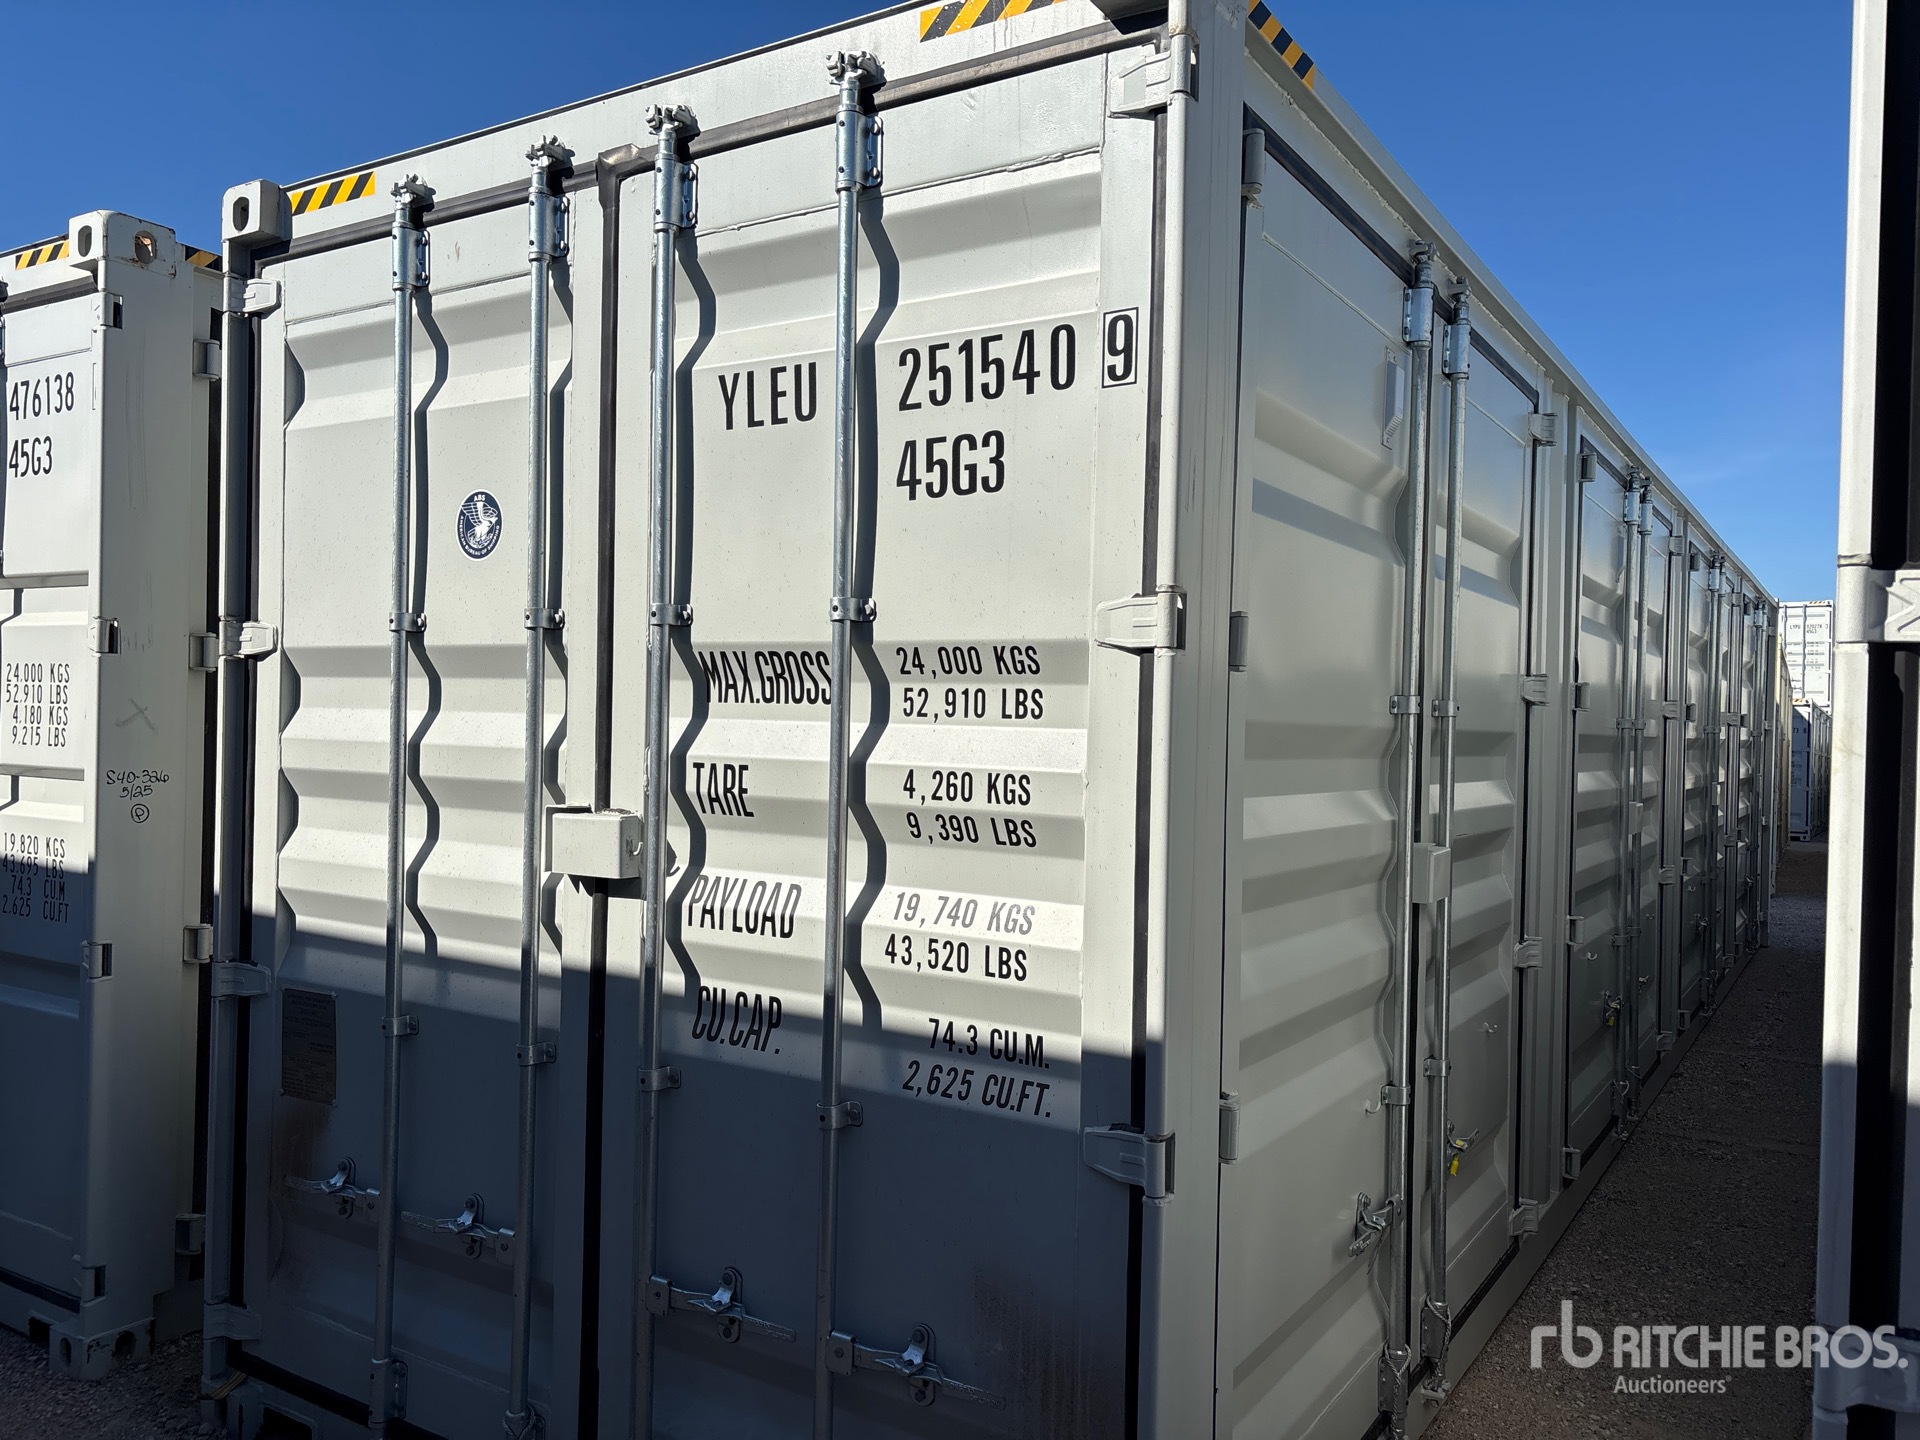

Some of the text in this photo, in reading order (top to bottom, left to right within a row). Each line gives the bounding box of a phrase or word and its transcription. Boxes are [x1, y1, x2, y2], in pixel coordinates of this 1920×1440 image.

[718, 313, 1135, 430] YLEU 251540 9
[9, 371, 75, 421] 476138
[8, 435, 53, 478] 45G3
[896, 430, 1005, 501] 45G3
[473, 494, 486, 502] ABS
[6, 662, 70, 684] 24,000 KGS
[698, 645, 1041, 705] MAX.GROSS 24,000 KGS
[6, 683, 68, 705] 52,910 LBS
[903, 687, 1044, 723] 52,910 LBS
[13, 704, 69, 726] 4,180 KGS
[12, 725, 66, 748] 9,215 LBS
[119, 783, 153, 801] 5/25
[693, 762, 1031, 818] TARE 4,260 KGS
[46, 836, 65, 859] KGS
[906, 812, 1037, 848] 9,390 LBS
[12, 874, 32, 896] 74.3
[46, 857, 64, 880] LBS
[687, 874, 1036, 939] PAYLOAD 19,740 KGS
[884, 933, 1028, 981] 43,520 LBS
[691, 985, 1051, 1069] CU.CAP. 74.3 CU.M.
[902, 1060, 1052, 1118] 2,625 CU.FT.
